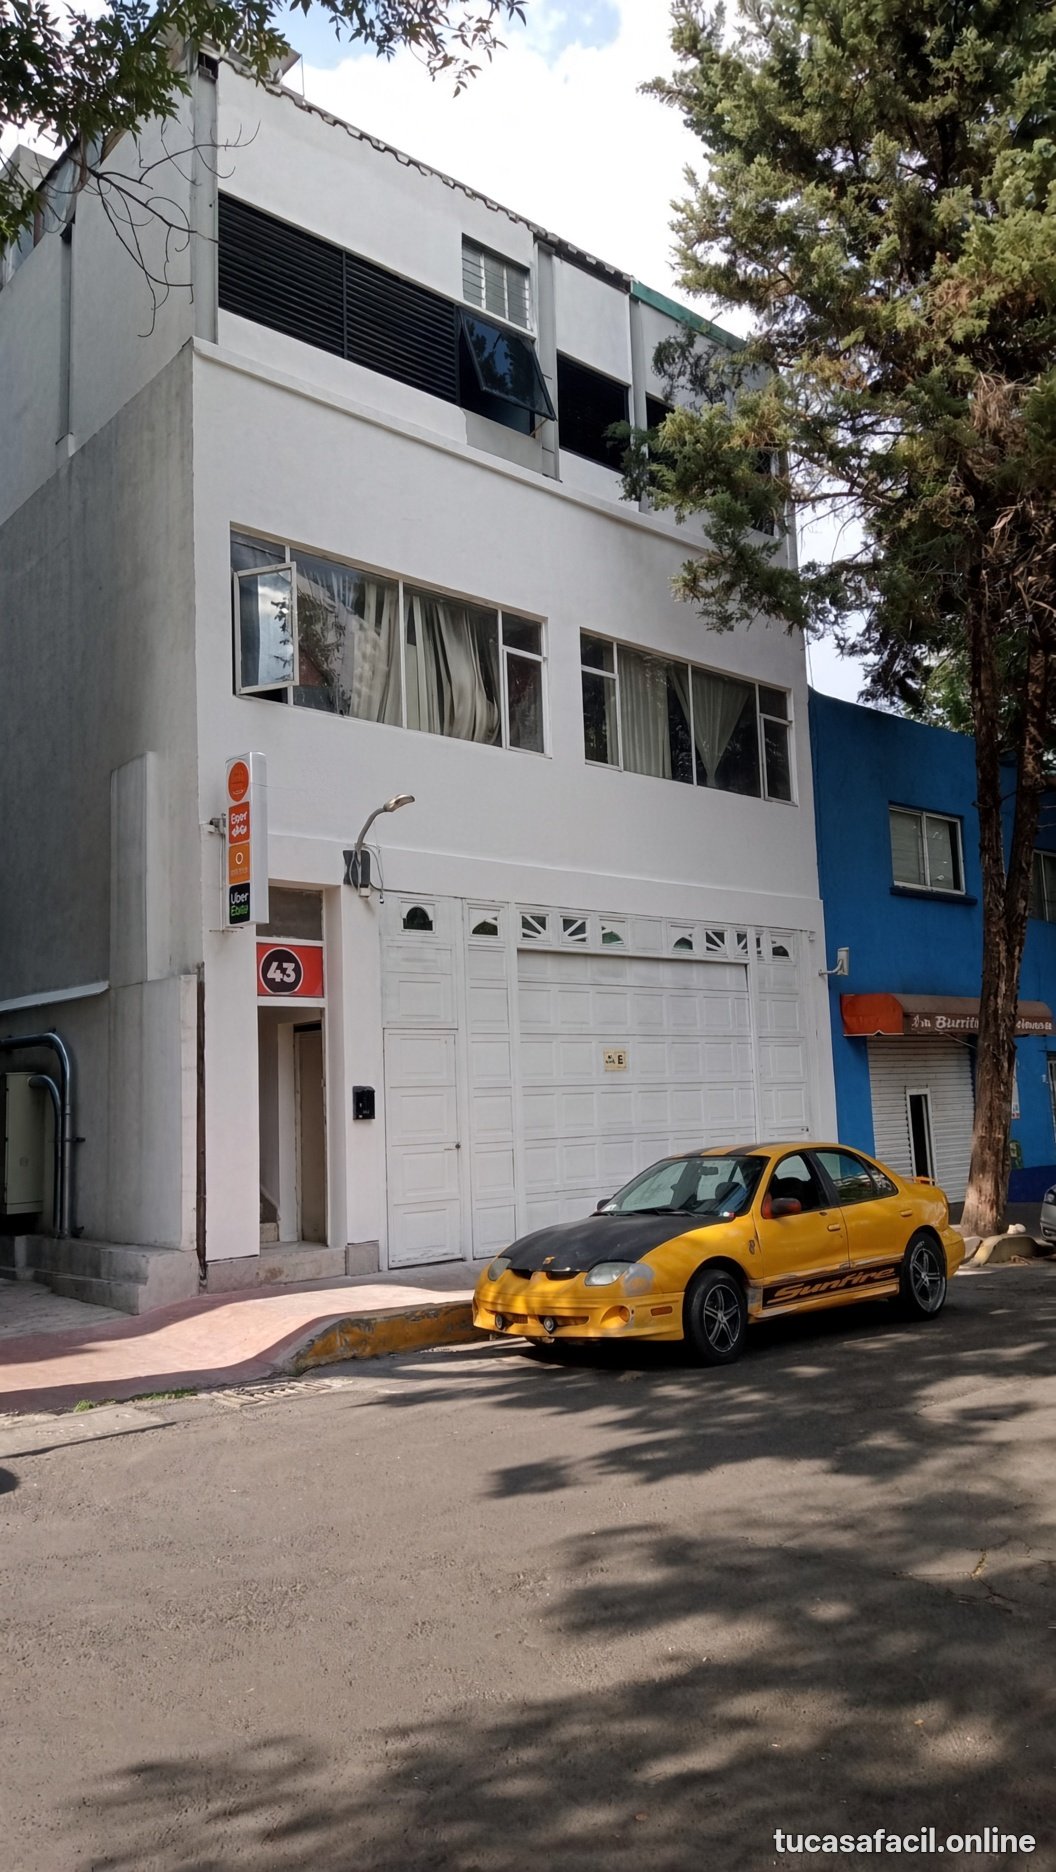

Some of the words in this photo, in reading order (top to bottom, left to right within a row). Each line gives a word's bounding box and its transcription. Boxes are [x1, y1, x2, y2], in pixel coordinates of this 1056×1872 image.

[230, 892, 249, 904] Uber
[266, 961, 296, 983] 43
[766, 1267, 896, 1305] Sunfire
